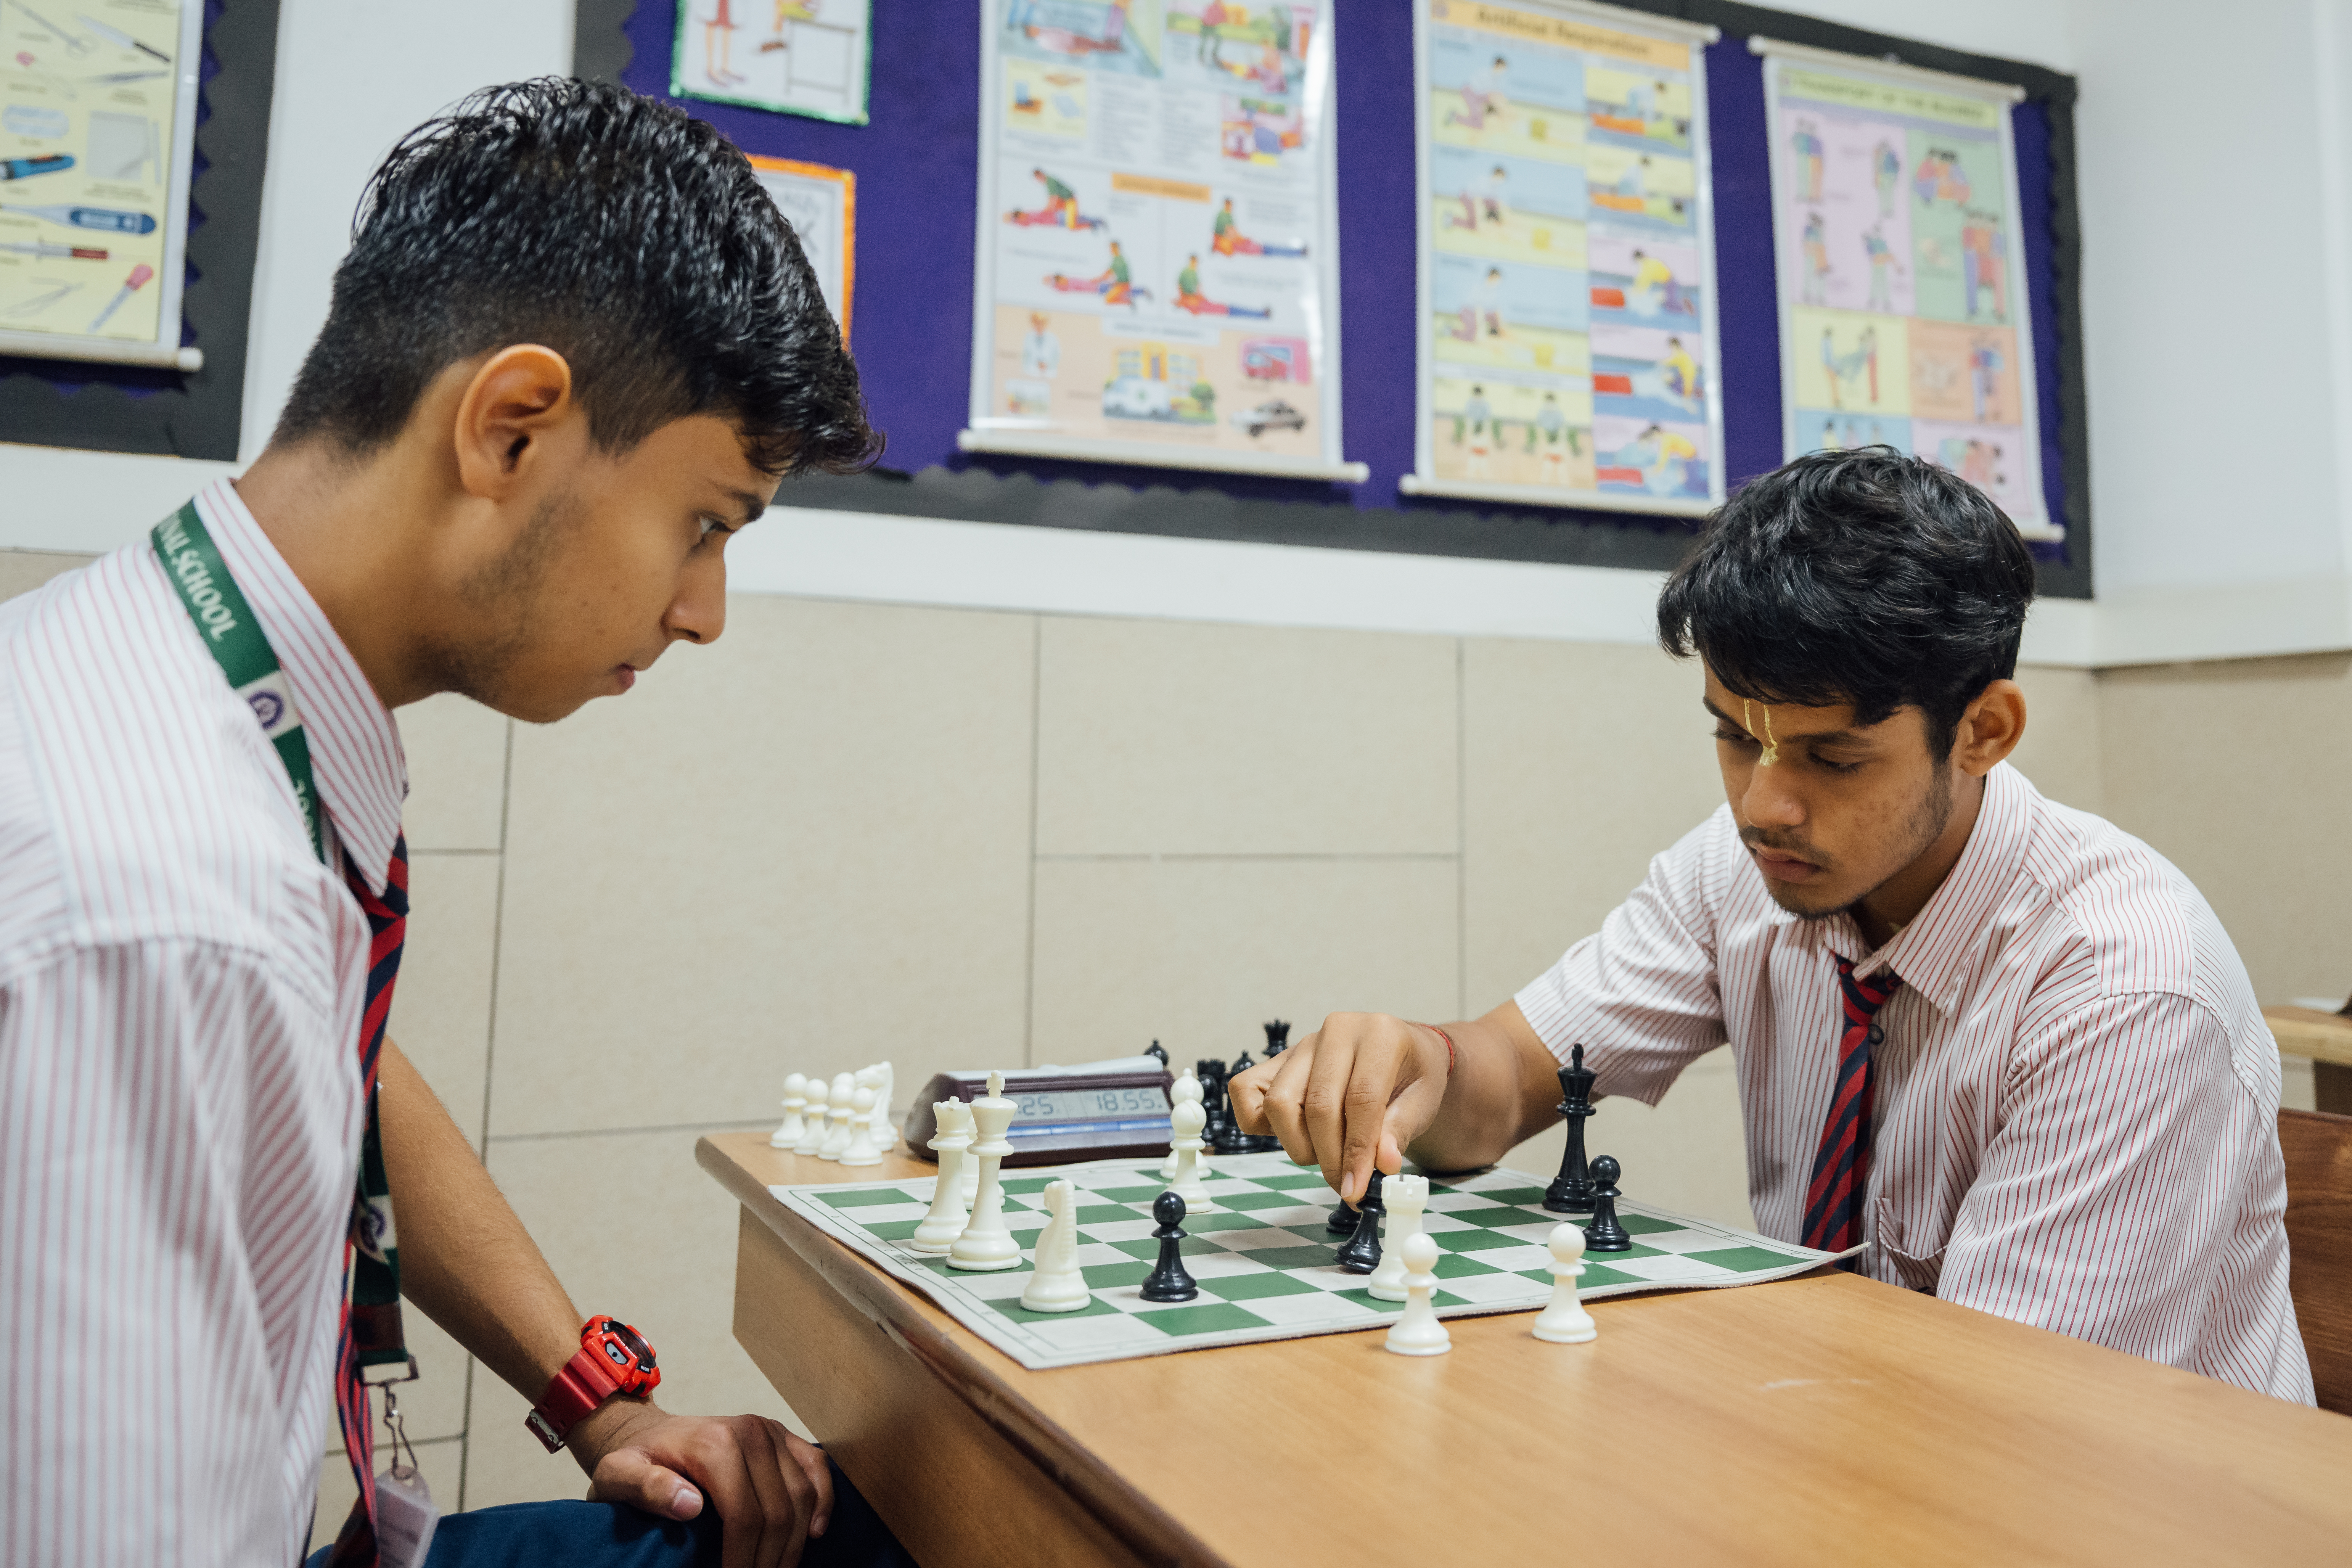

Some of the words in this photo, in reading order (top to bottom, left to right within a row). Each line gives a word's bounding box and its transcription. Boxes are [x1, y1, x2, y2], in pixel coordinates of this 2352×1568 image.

[172, 549, 237, 642] SCHOOL
[891, 1254, 918, 1265] WHITE
[613, 1333, 625, 1346] WATER
[625, 1346, 638, 1359] RESIST
